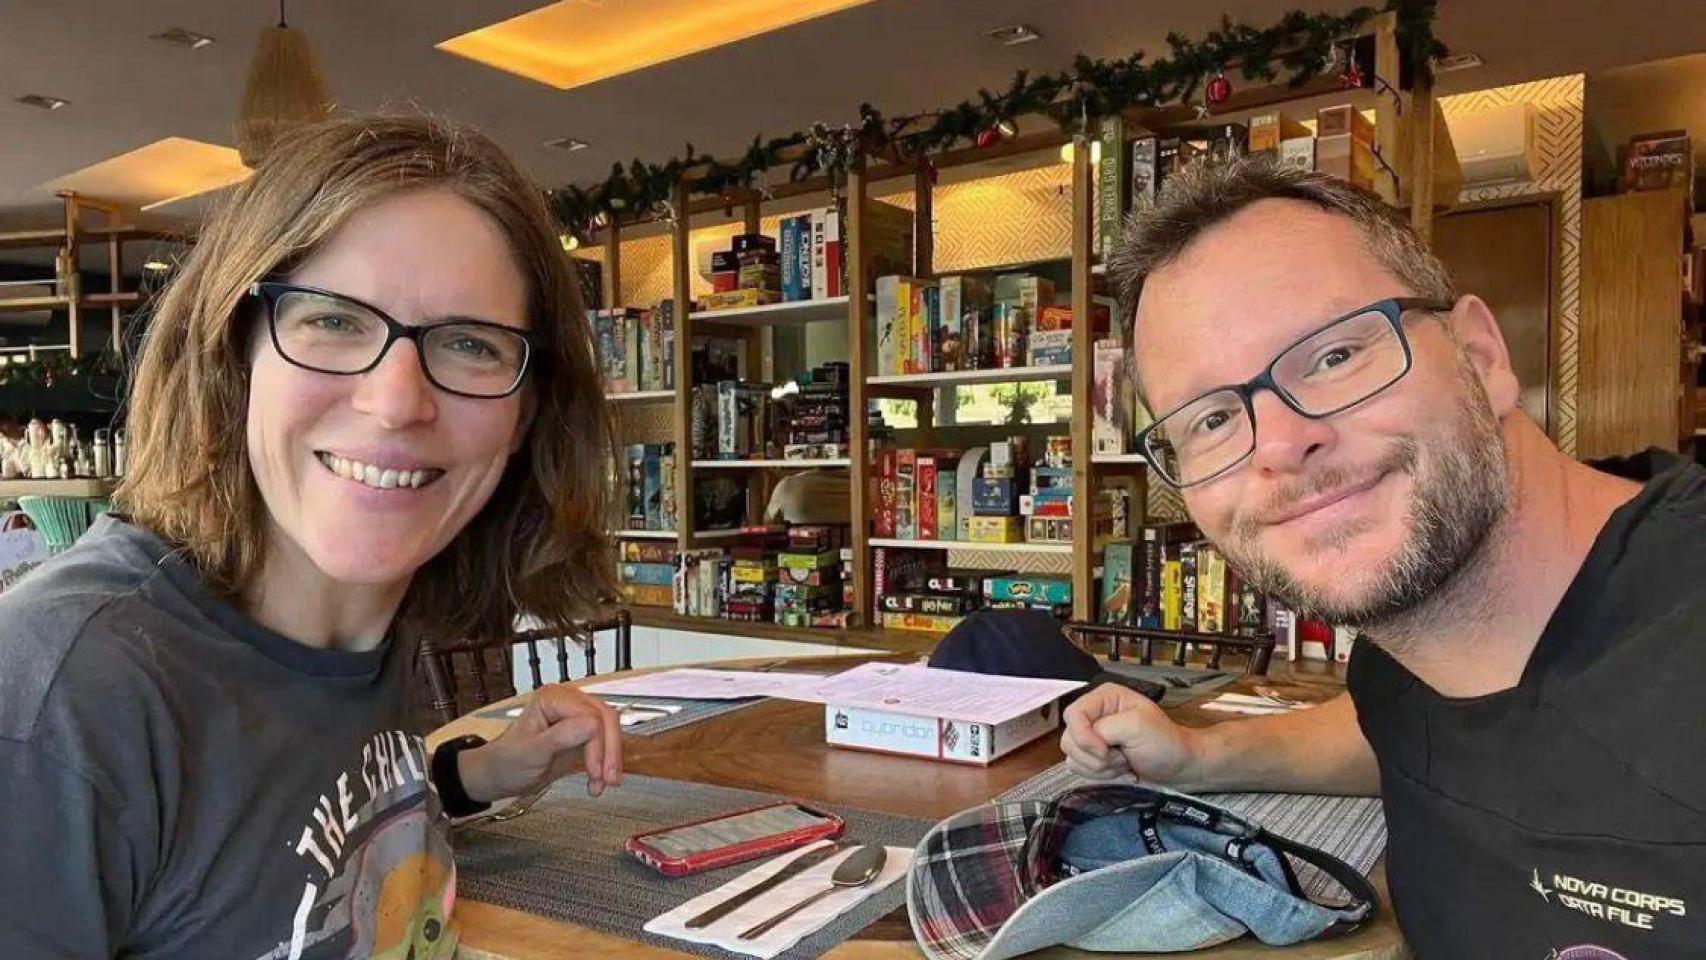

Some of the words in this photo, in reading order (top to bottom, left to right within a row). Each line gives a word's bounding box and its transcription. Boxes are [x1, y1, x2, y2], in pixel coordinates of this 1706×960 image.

[1103, 157, 1116, 180] GRID
[1103, 181, 1115, 220] POWER
[296, 771, 359, 878] THE
[1554, 874, 1607, 899] NOVA
[1611, 887, 1686, 916] CORPS
[1558, 894, 1604, 920] DATA
[1608, 906, 1653, 930] FILE
